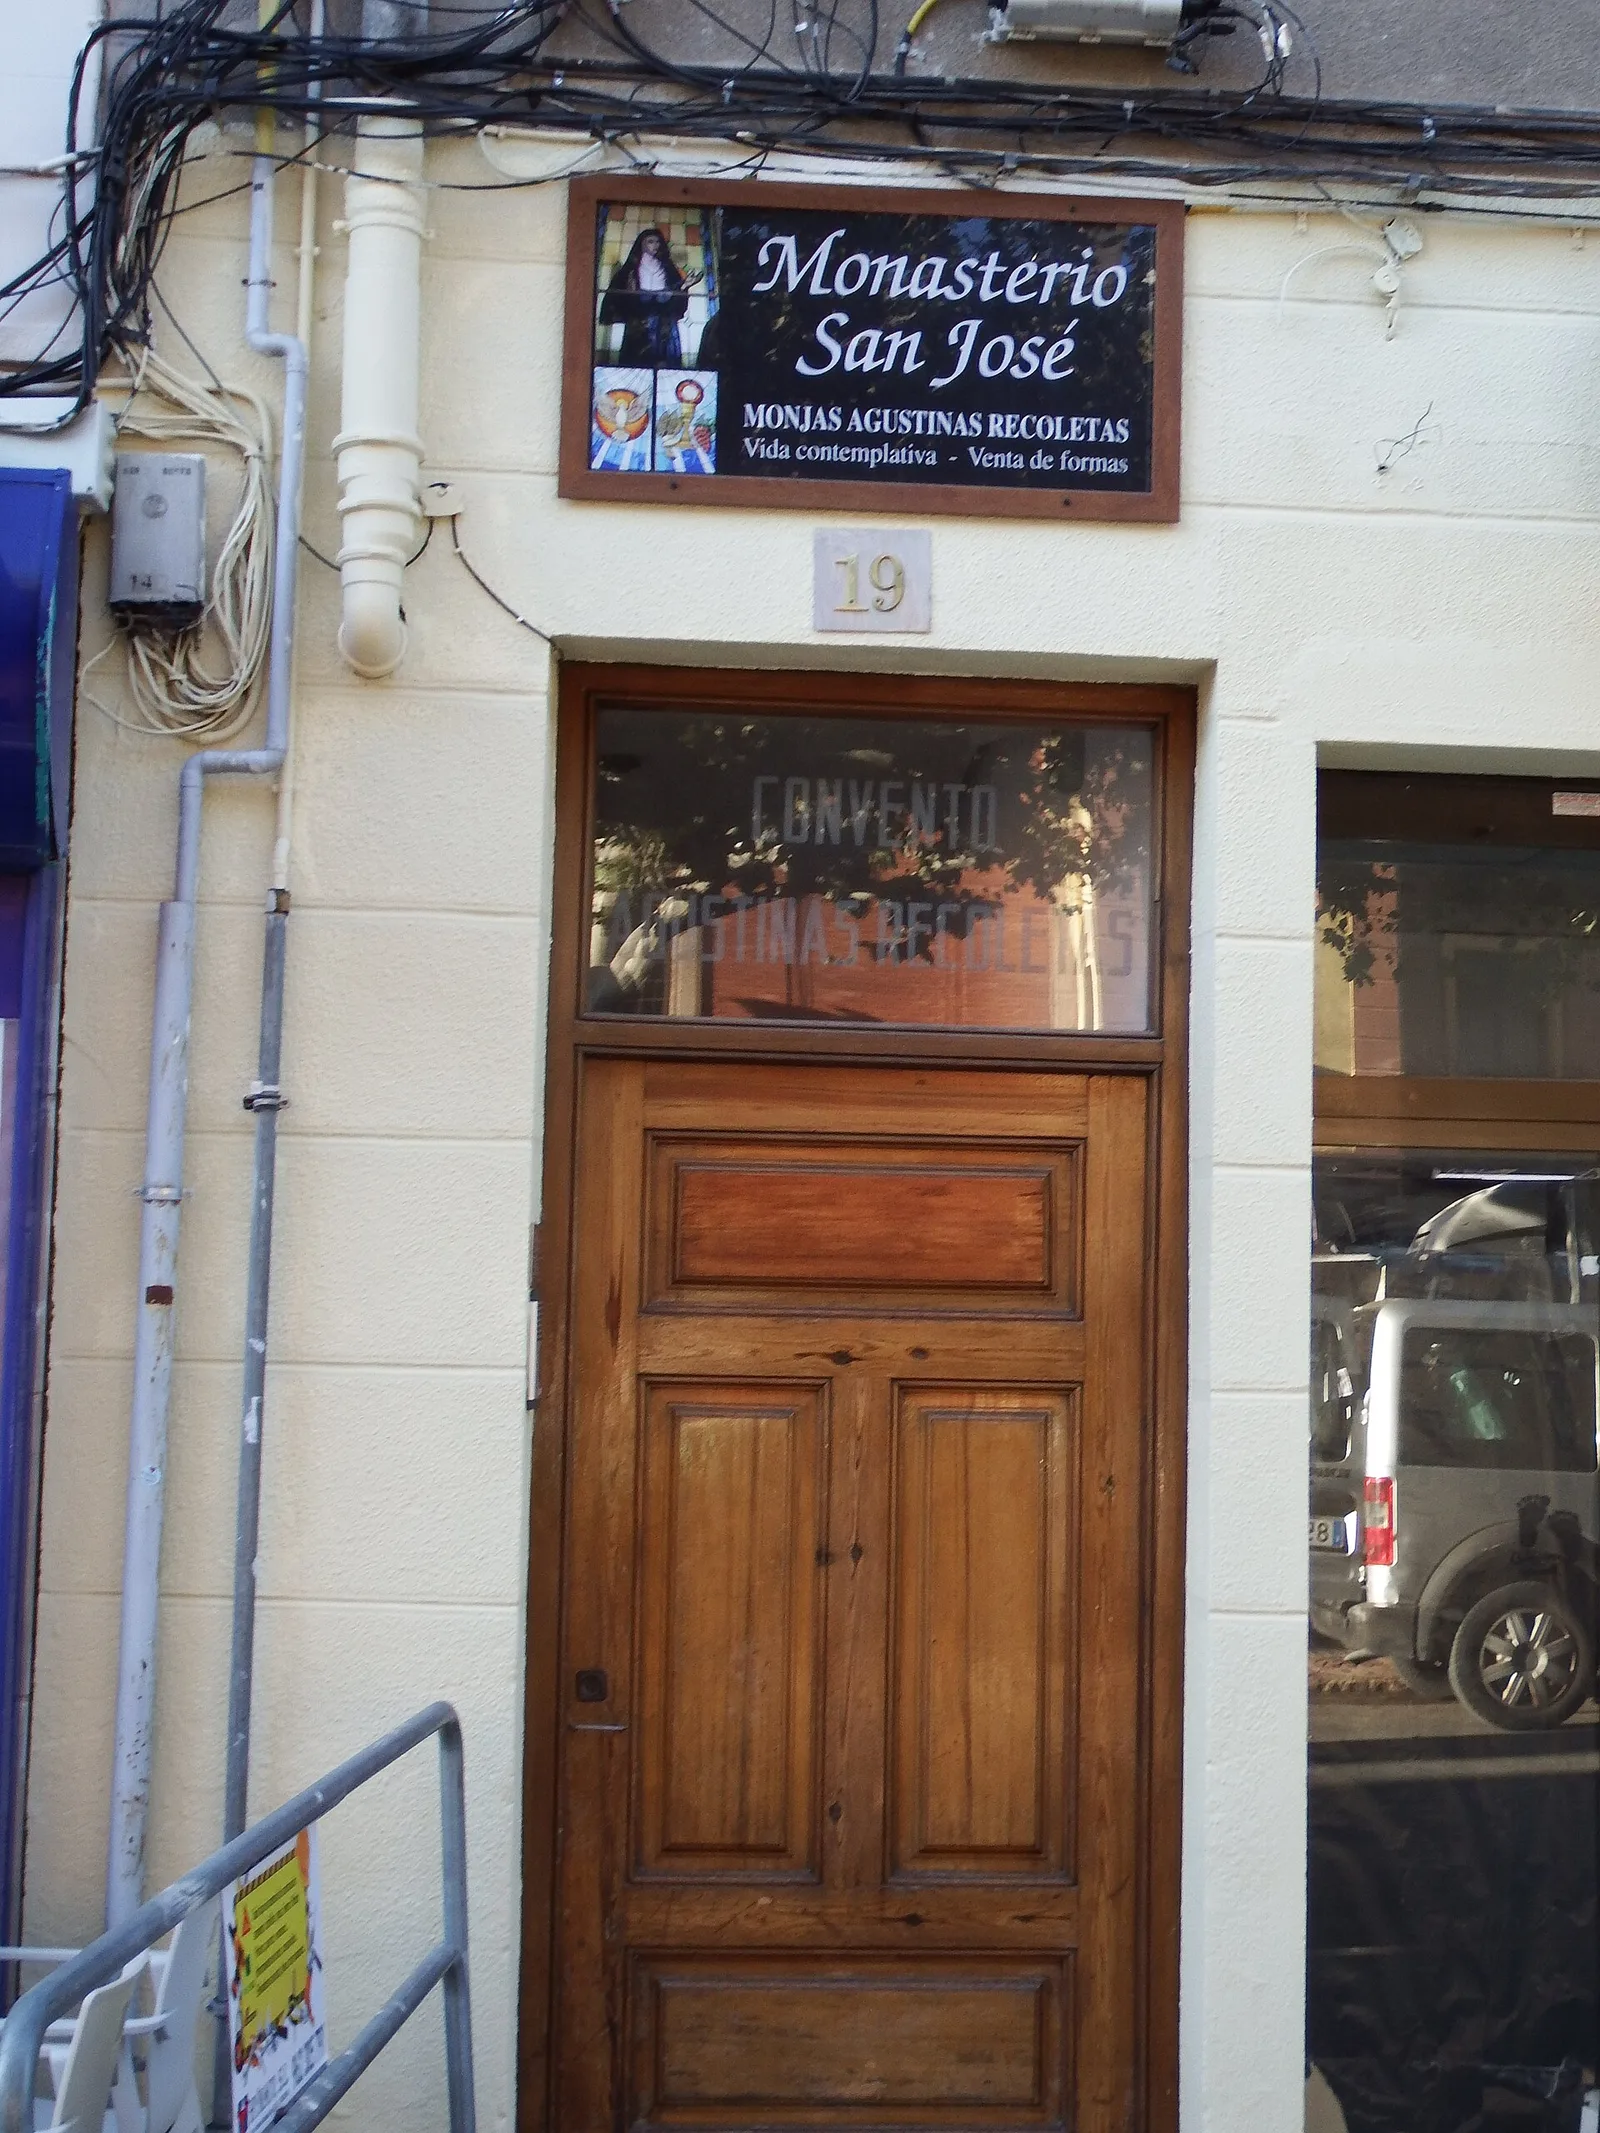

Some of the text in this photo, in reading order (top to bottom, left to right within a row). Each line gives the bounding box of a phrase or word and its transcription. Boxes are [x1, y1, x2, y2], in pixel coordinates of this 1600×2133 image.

[752, 229, 1128, 308] Monasterio
[795, 312, 1080, 391] San José
[743, 403, 1130, 444] MONJAS AGUSTINAS RECOLETAS
[743, 436, 791, 460] Vida
[795, 442, 937, 469] contemplativa
[967, 446, 1025, 469] Venta
[1029, 448, 1055, 470] de
[1058, 449, 1130, 474] formas
[832, 553, 907, 613] 19
[752, 775, 998, 852] CONVENTO
[876, 900, 1134, 976] RECOLETS
